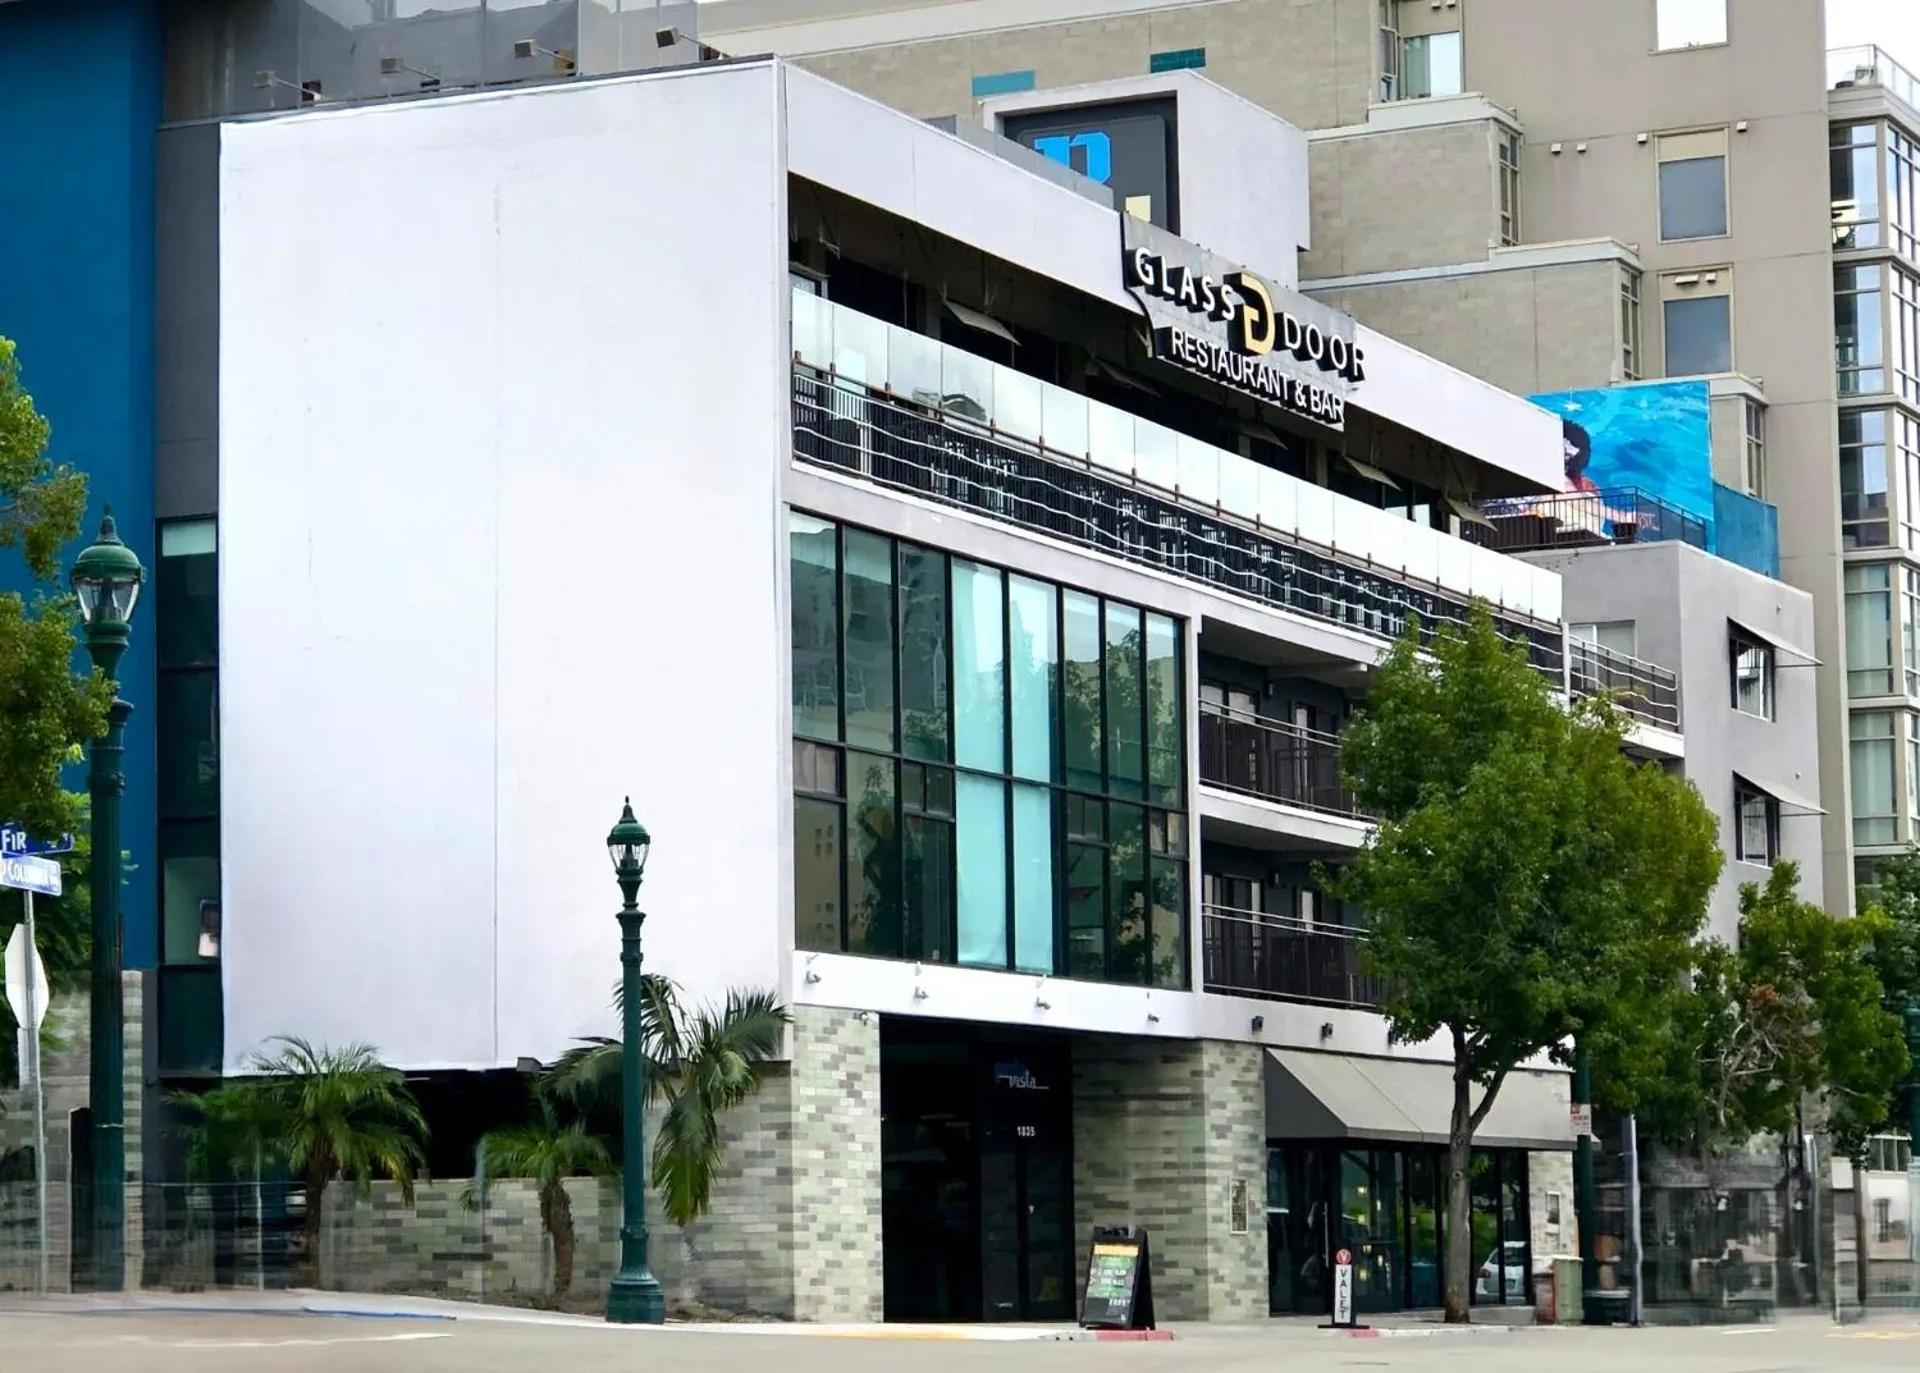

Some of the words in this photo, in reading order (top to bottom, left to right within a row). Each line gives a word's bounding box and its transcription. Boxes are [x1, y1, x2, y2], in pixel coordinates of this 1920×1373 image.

[1135, 247, 1236, 321] GLASS
[1283, 312, 1368, 381] DOOR
[1171, 326, 1290, 401] RESTAURANT
[1295, 379, 1308, 409] &
[1310, 384, 1346, 425] BAR
[1339, 1268, 1348, 1320] VALET
